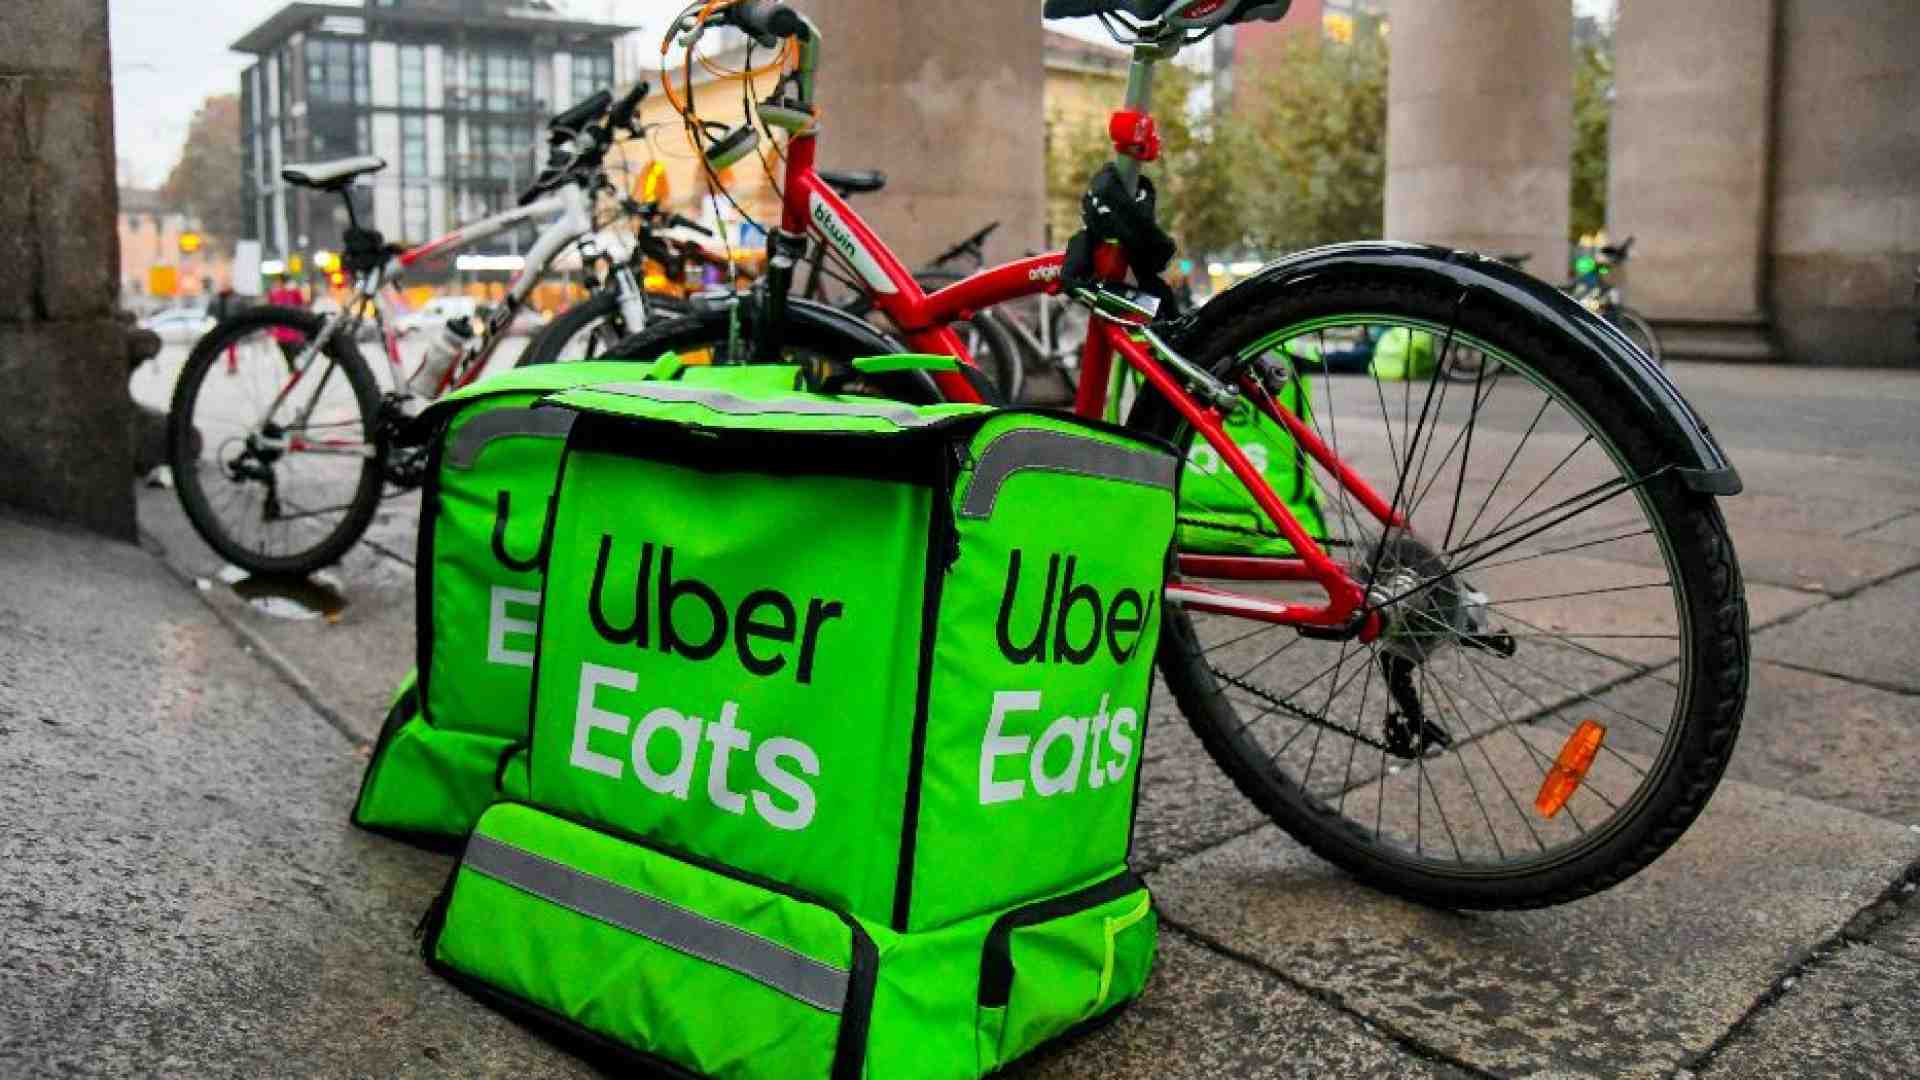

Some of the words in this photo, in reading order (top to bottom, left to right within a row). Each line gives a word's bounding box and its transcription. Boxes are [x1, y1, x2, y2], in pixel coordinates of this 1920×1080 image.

[814, 202, 856, 257] btwin
[589, 534, 843, 685] Uber
[570, 662, 820, 831] Eats
[979, 690, 1137, 805] Eats
